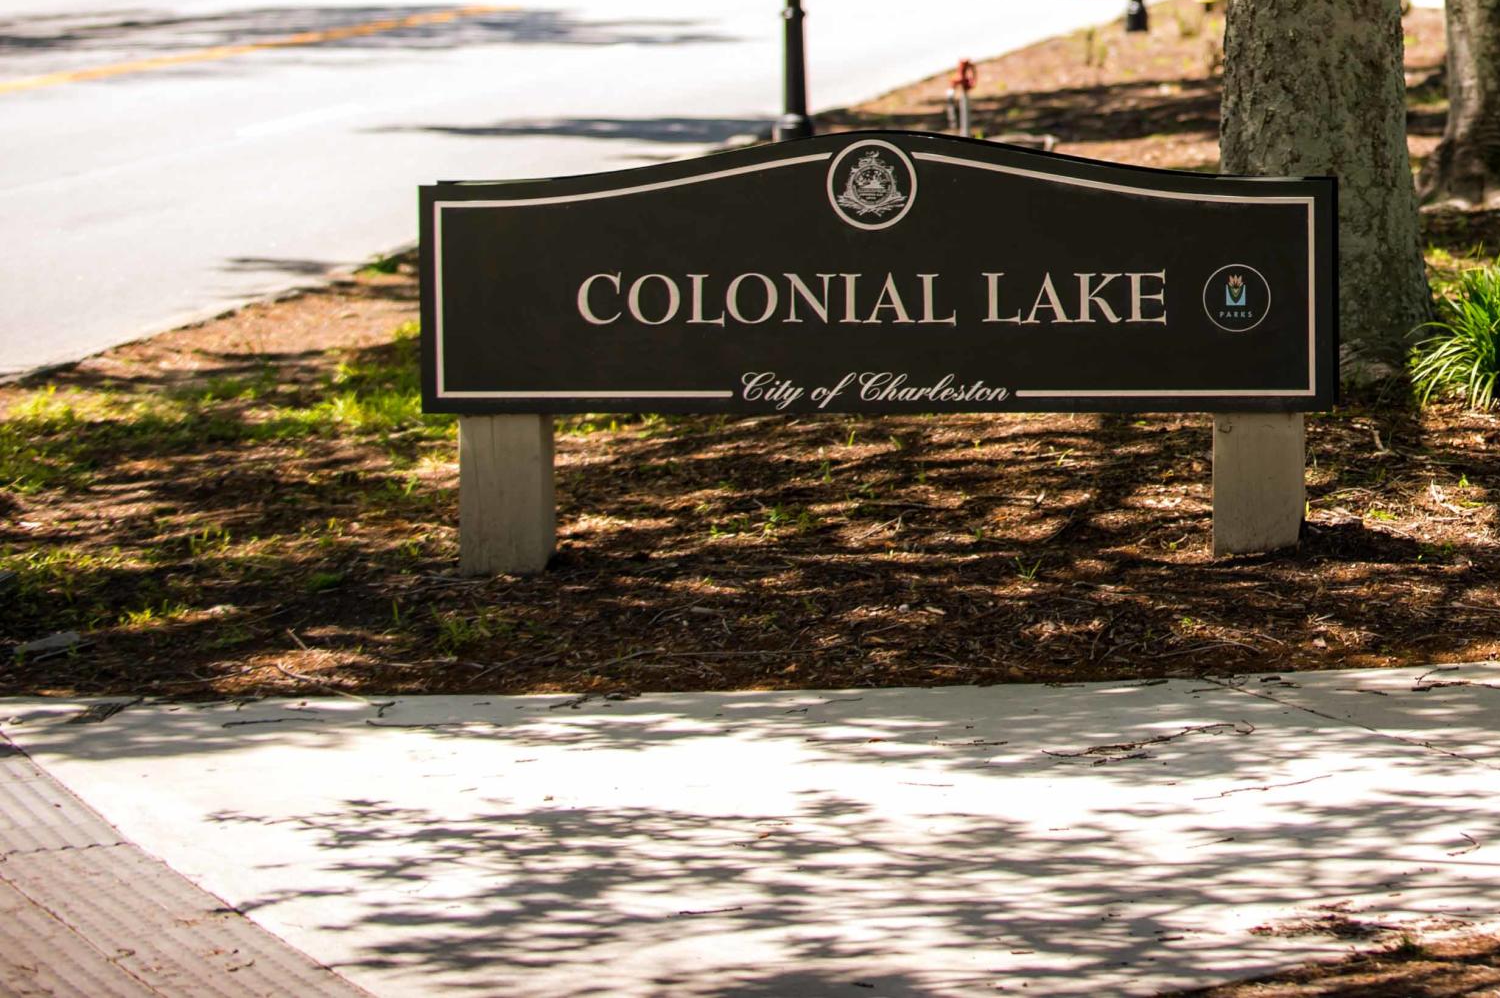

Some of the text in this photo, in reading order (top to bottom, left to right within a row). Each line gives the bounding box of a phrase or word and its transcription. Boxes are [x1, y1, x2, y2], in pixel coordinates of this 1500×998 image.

[577, 269, 1168, 327] COLONIAL LAKE
[1218, 310, 1253, 318] PARKS
[741, 371, 1010, 410] City of Charleston
